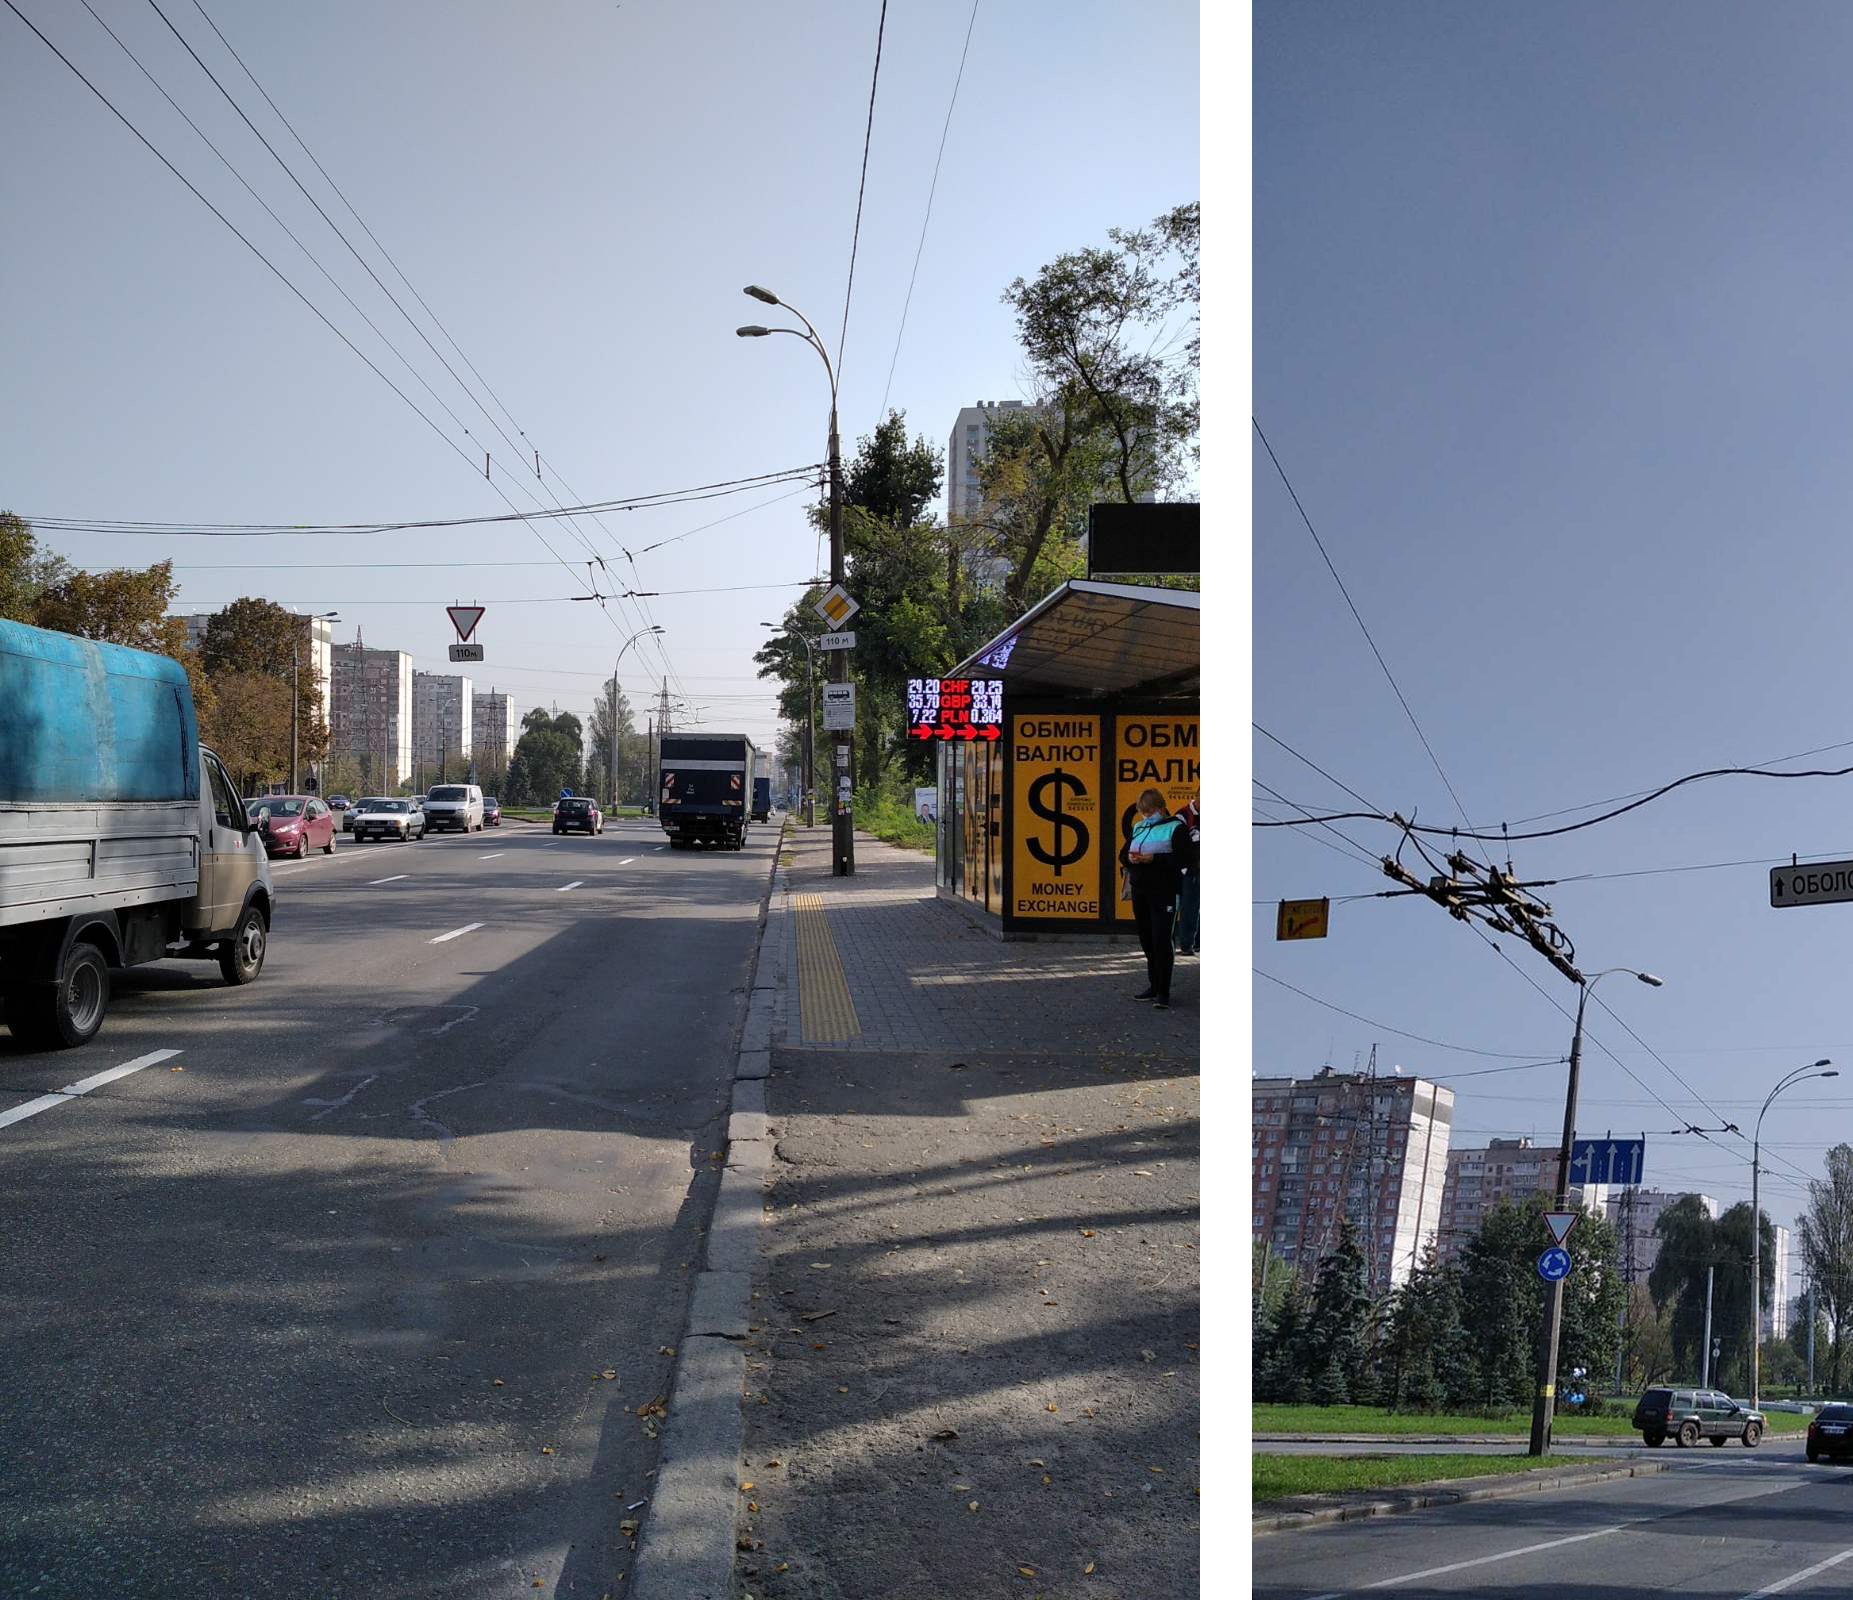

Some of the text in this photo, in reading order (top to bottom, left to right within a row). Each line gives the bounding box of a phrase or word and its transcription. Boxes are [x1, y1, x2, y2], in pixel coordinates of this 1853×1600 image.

[827, 637, 840, 646] 110
[908, 679, 940, 694] 29.20
[941, 680, 970, 693] CHF
[908, 694, 940, 709] 35.70
[941, 695, 971, 708] GBP
[912, 709, 936, 723] 7.22
[941, 710, 969, 723] PLN
[1020, 721, 1093, 738] ОБМІН
[1016, 745, 1098, 762] ВАЛЮТ
[1026, 767, 1090, 877] $
[1031, 883, 1084, 896] MONEY
[1018, 900, 1099, 914] EXCHANGE
